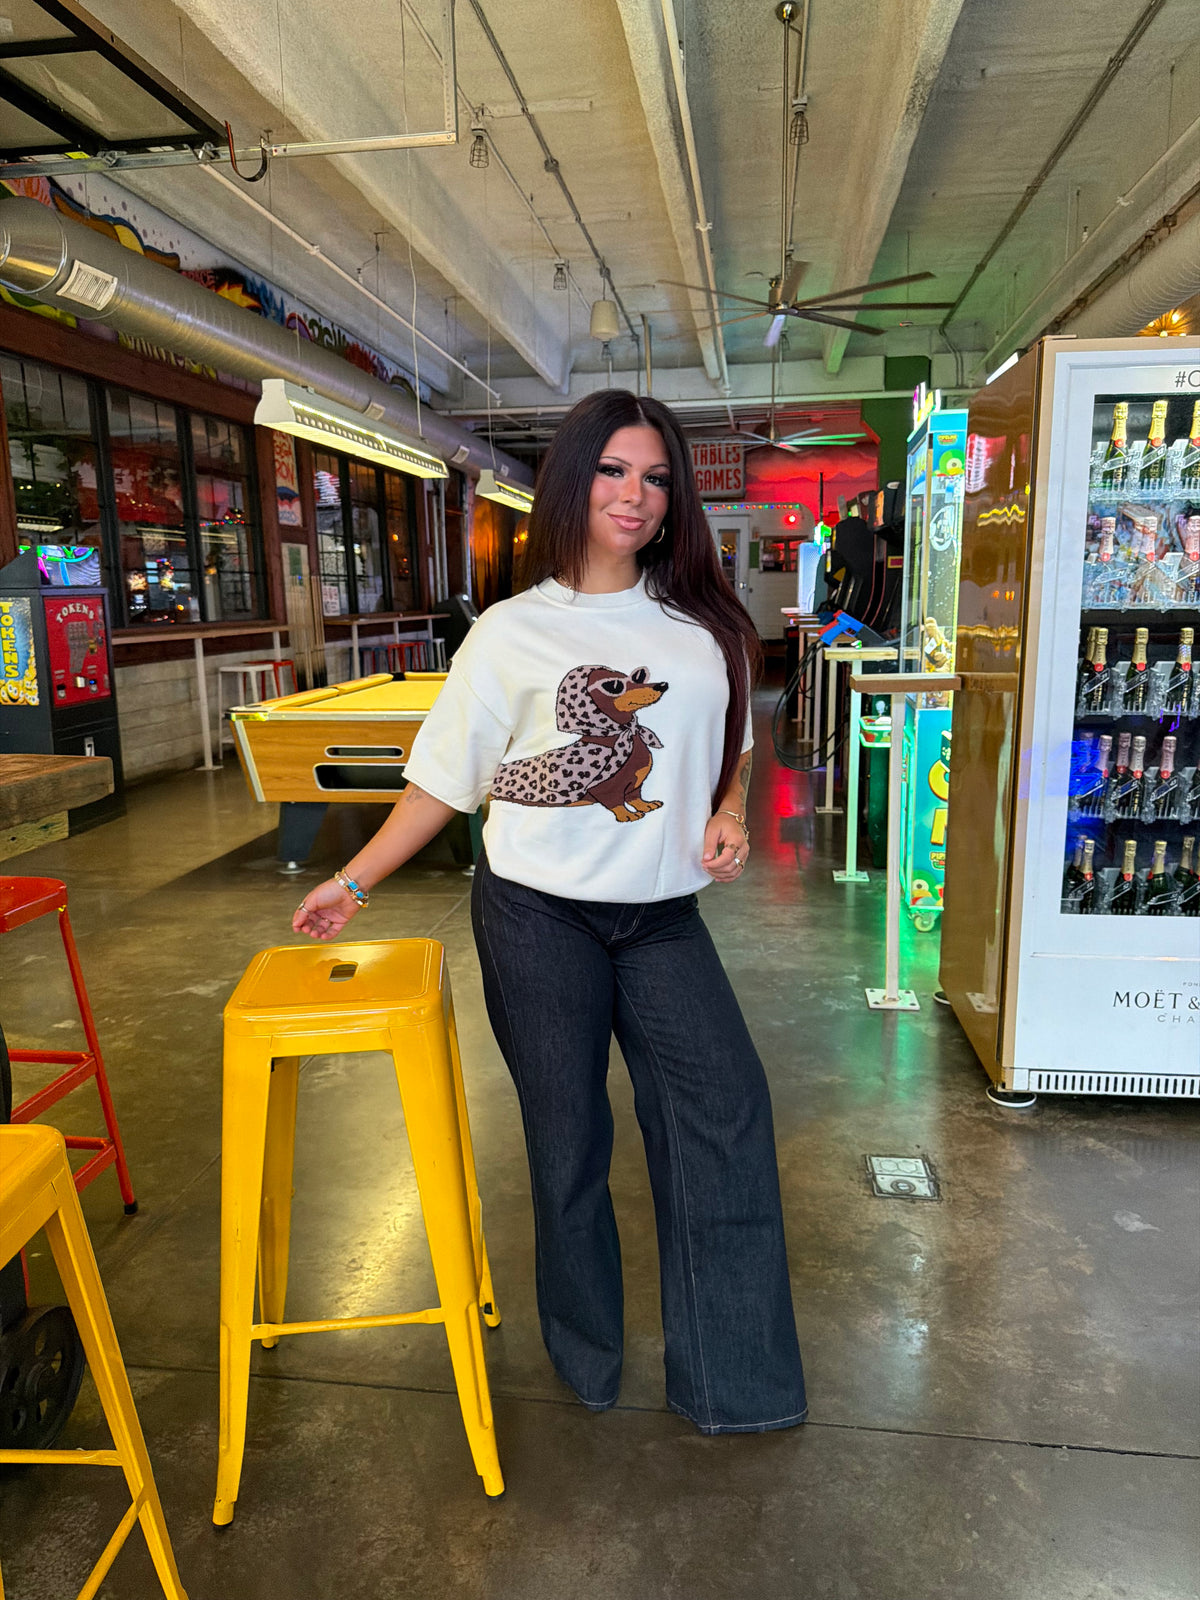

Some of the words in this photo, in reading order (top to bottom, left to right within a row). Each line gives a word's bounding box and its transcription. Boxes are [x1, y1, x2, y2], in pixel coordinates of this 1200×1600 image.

[692, 443, 741, 466] TABLES
[695, 468, 741, 491] GAMES
[56, 603, 94, 623] TOKENS
[0, 601, 19, 678] TOKENS
[1112, 989, 1183, 1009] MOËT
[1188, 995, 1200, 1010] &
